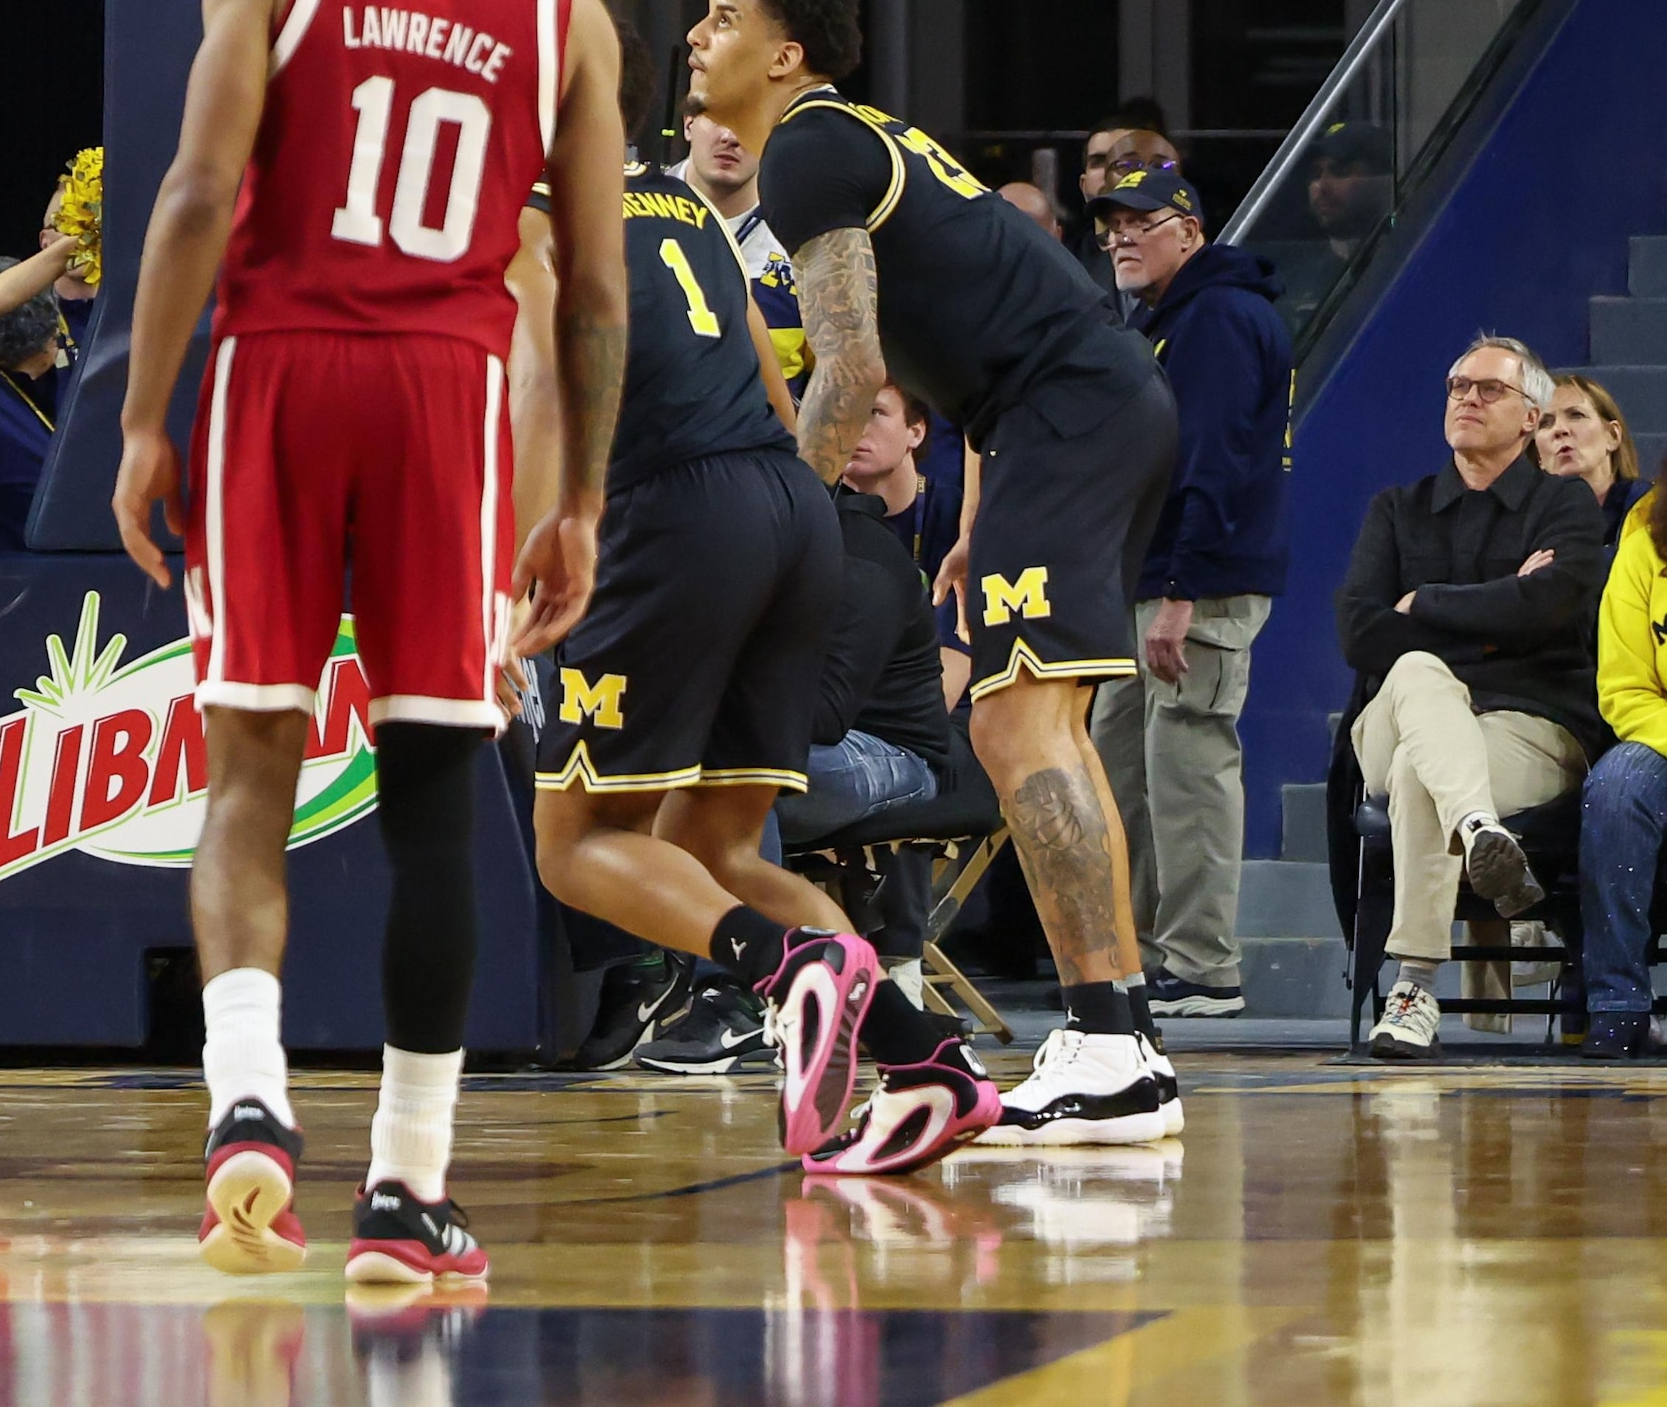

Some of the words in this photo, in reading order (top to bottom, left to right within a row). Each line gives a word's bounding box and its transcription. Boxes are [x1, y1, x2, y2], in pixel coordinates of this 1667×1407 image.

[341, 6, 514, 83] LAWRENCE
[330, 75, 493, 263] 10
[622, 190, 708, 230] ENNEY
[659, 237, 721, 339] 1
[981, 564, 1052, 629] M
[558, 664, 628, 731] M
